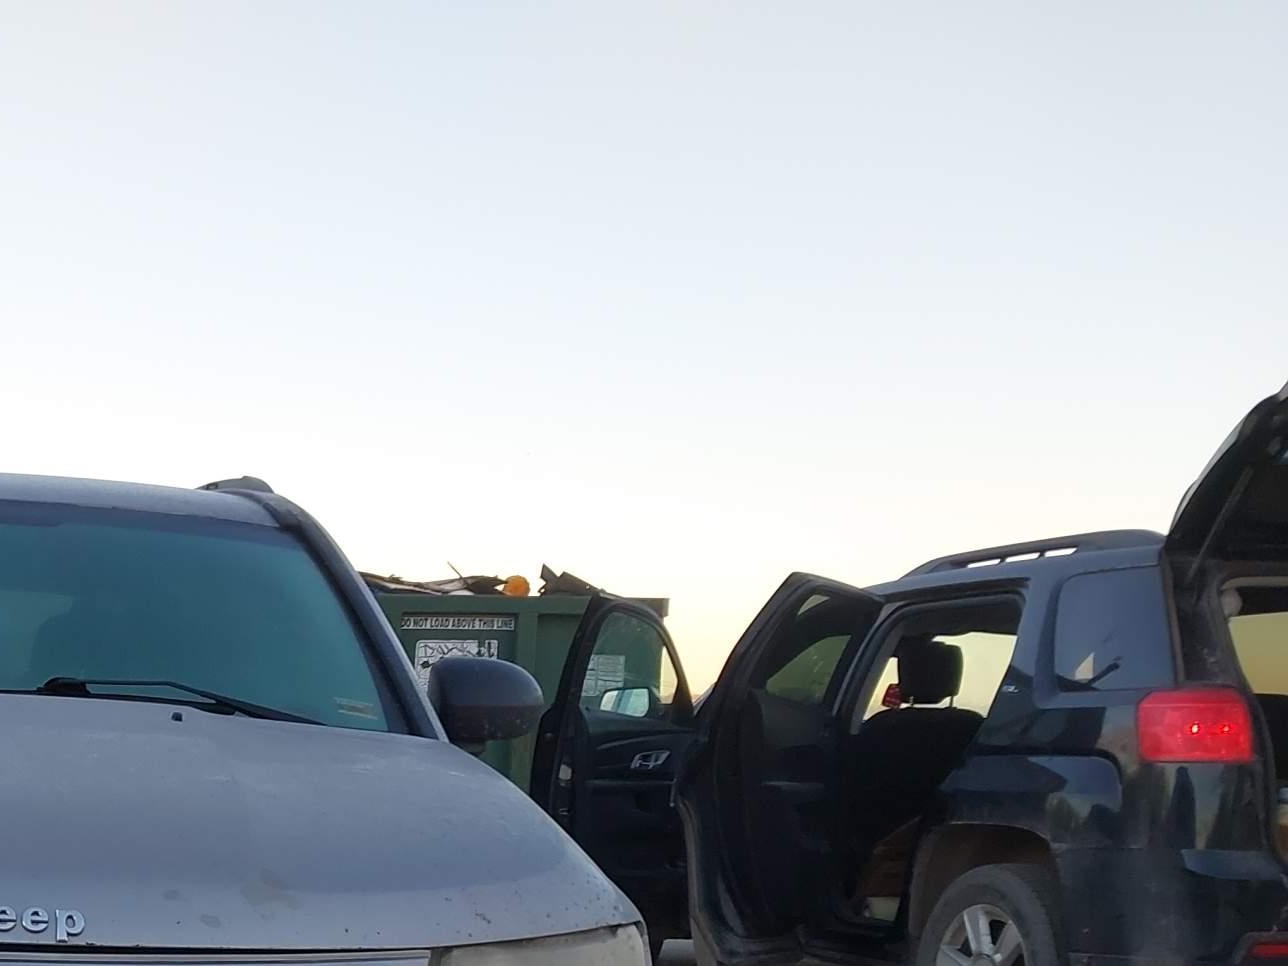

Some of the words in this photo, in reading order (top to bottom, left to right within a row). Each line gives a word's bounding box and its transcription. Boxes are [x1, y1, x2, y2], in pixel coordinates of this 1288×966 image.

[400, 617, 411, 628] DO
[413, 617, 429, 628] NOT
[430, 617, 450, 628] LOAD
[451, 617, 476, 629] ABOVE
[478, 618, 494, 629] THIS
[496, 618, 513, 629] LINE
